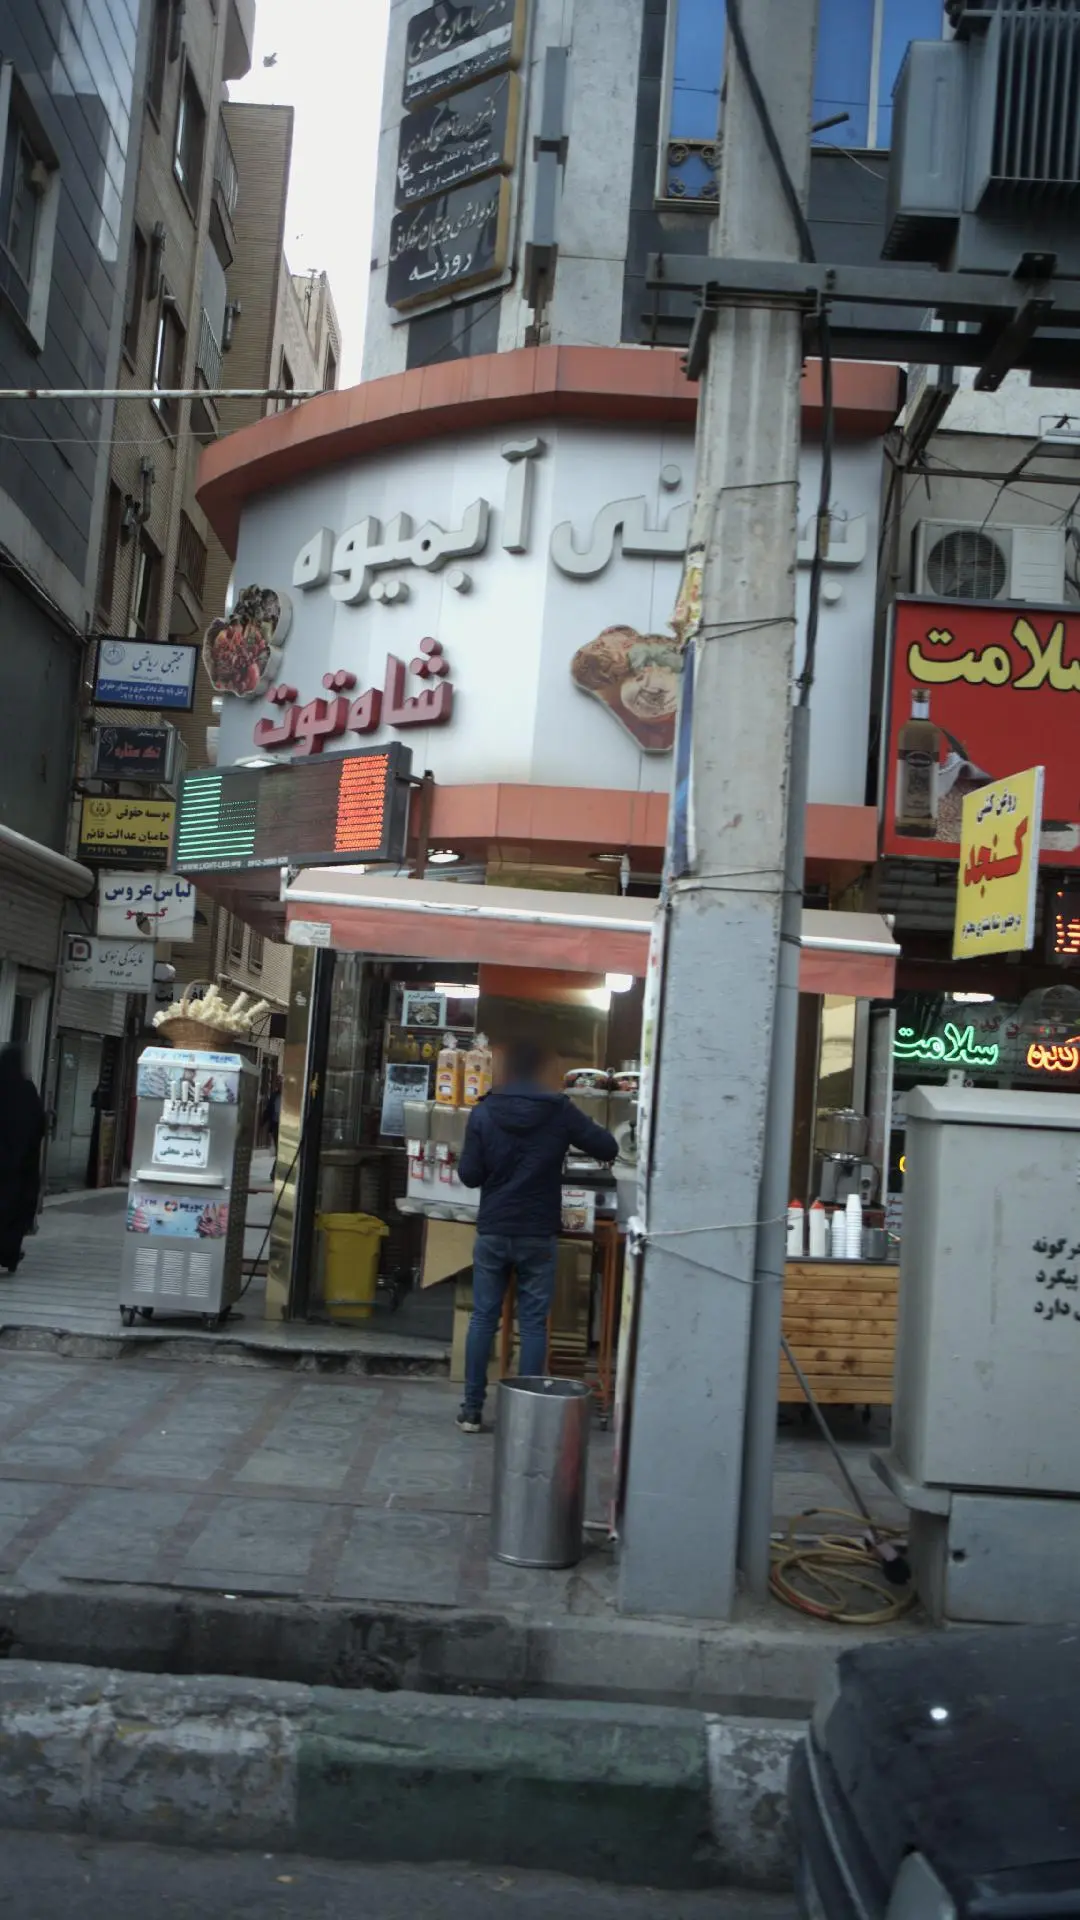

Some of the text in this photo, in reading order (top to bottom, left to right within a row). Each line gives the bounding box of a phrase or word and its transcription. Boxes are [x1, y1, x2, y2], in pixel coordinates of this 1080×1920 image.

[409, 253, 471, 281] روزبه
[292, 436, 867, 606] بنی آبمیوه
[963, 816, 1029, 899] کنجد
[104, 881, 191, 902] لباس عروس
[891, 1021, 999, 1067] سلامت
[1034, 1298, 1071, 1321] دارد
